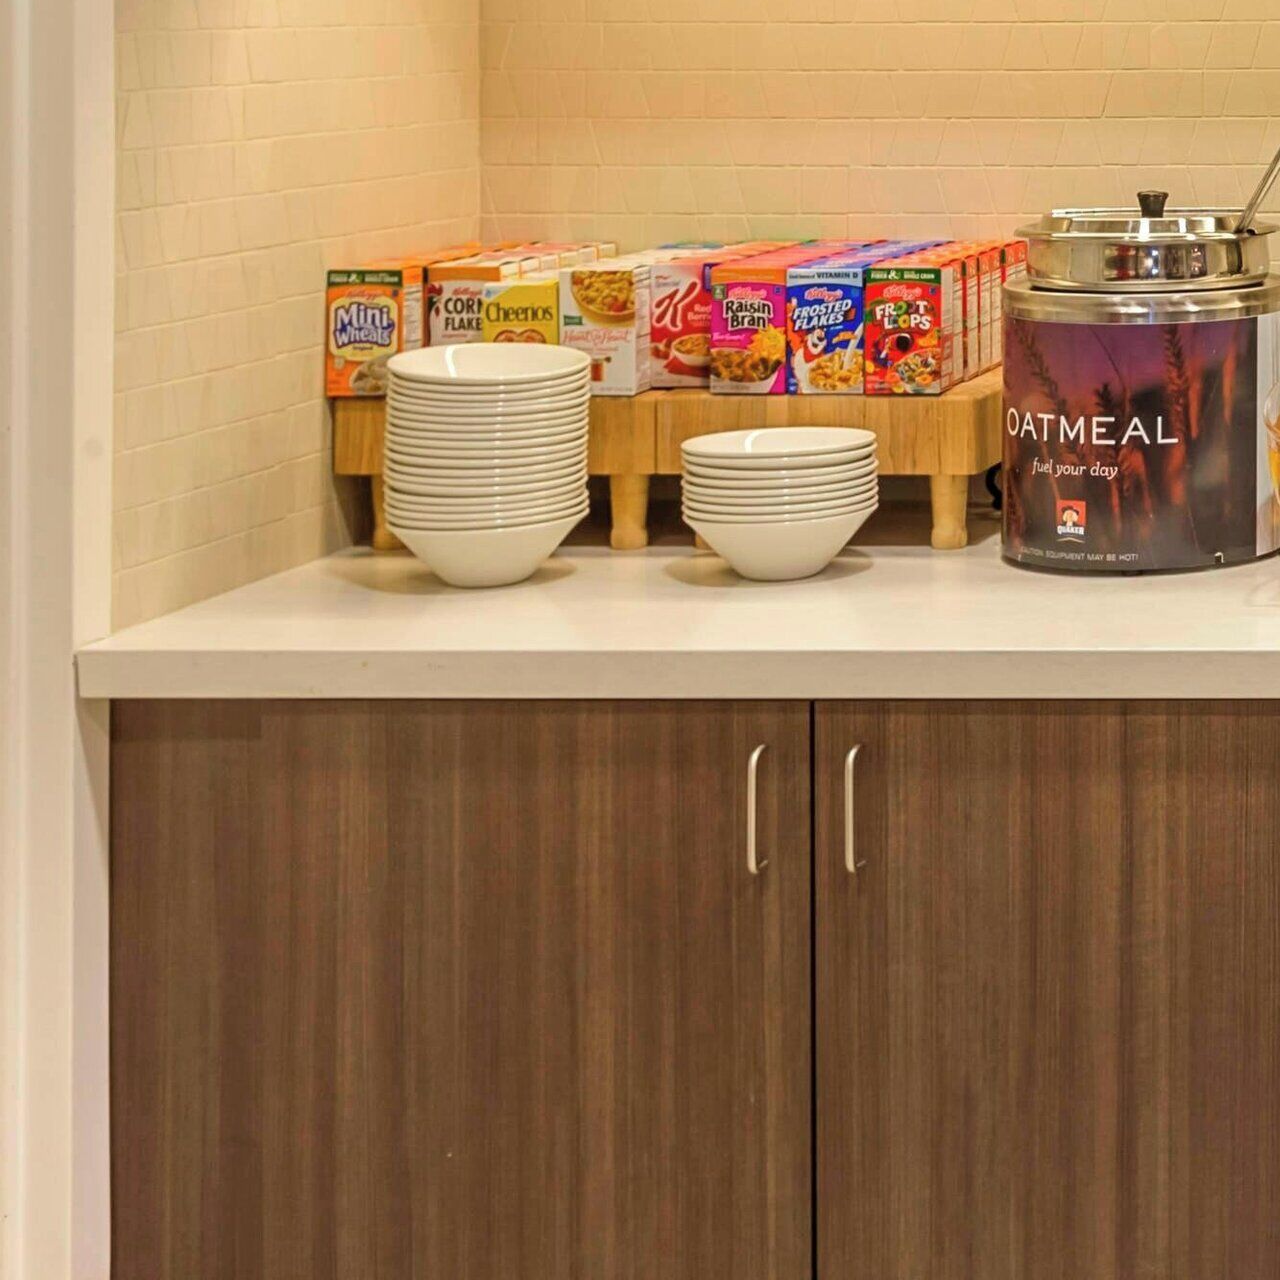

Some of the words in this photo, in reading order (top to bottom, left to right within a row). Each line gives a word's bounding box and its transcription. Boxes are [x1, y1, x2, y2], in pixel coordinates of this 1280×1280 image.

[336, 302, 390, 328] Mini
[486, 302, 553, 323] Cheerios
[653, 278, 700, 331] K
[725, 300, 772, 316] Raisin
[793, 299, 852, 320] FROSTED
[875, 300, 928, 321] FROOT
[730, 314, 767, 329] Bran
[794, 312, 844, 331] FLAKES
[884, 314, 931, 330] LOOPS
[335, 325, 393, 346] Wheats
[1006, 407, 1179, 446] OATMEAL
[1032, 457, 1053, 475] fuel
[1055, 461, 1087, 478] your
[1090, 461, 1118, 480] day
[1057, 525, 1085, 535] QUAKER
[1046, 550, 1085, 560] EQUIPMENT
